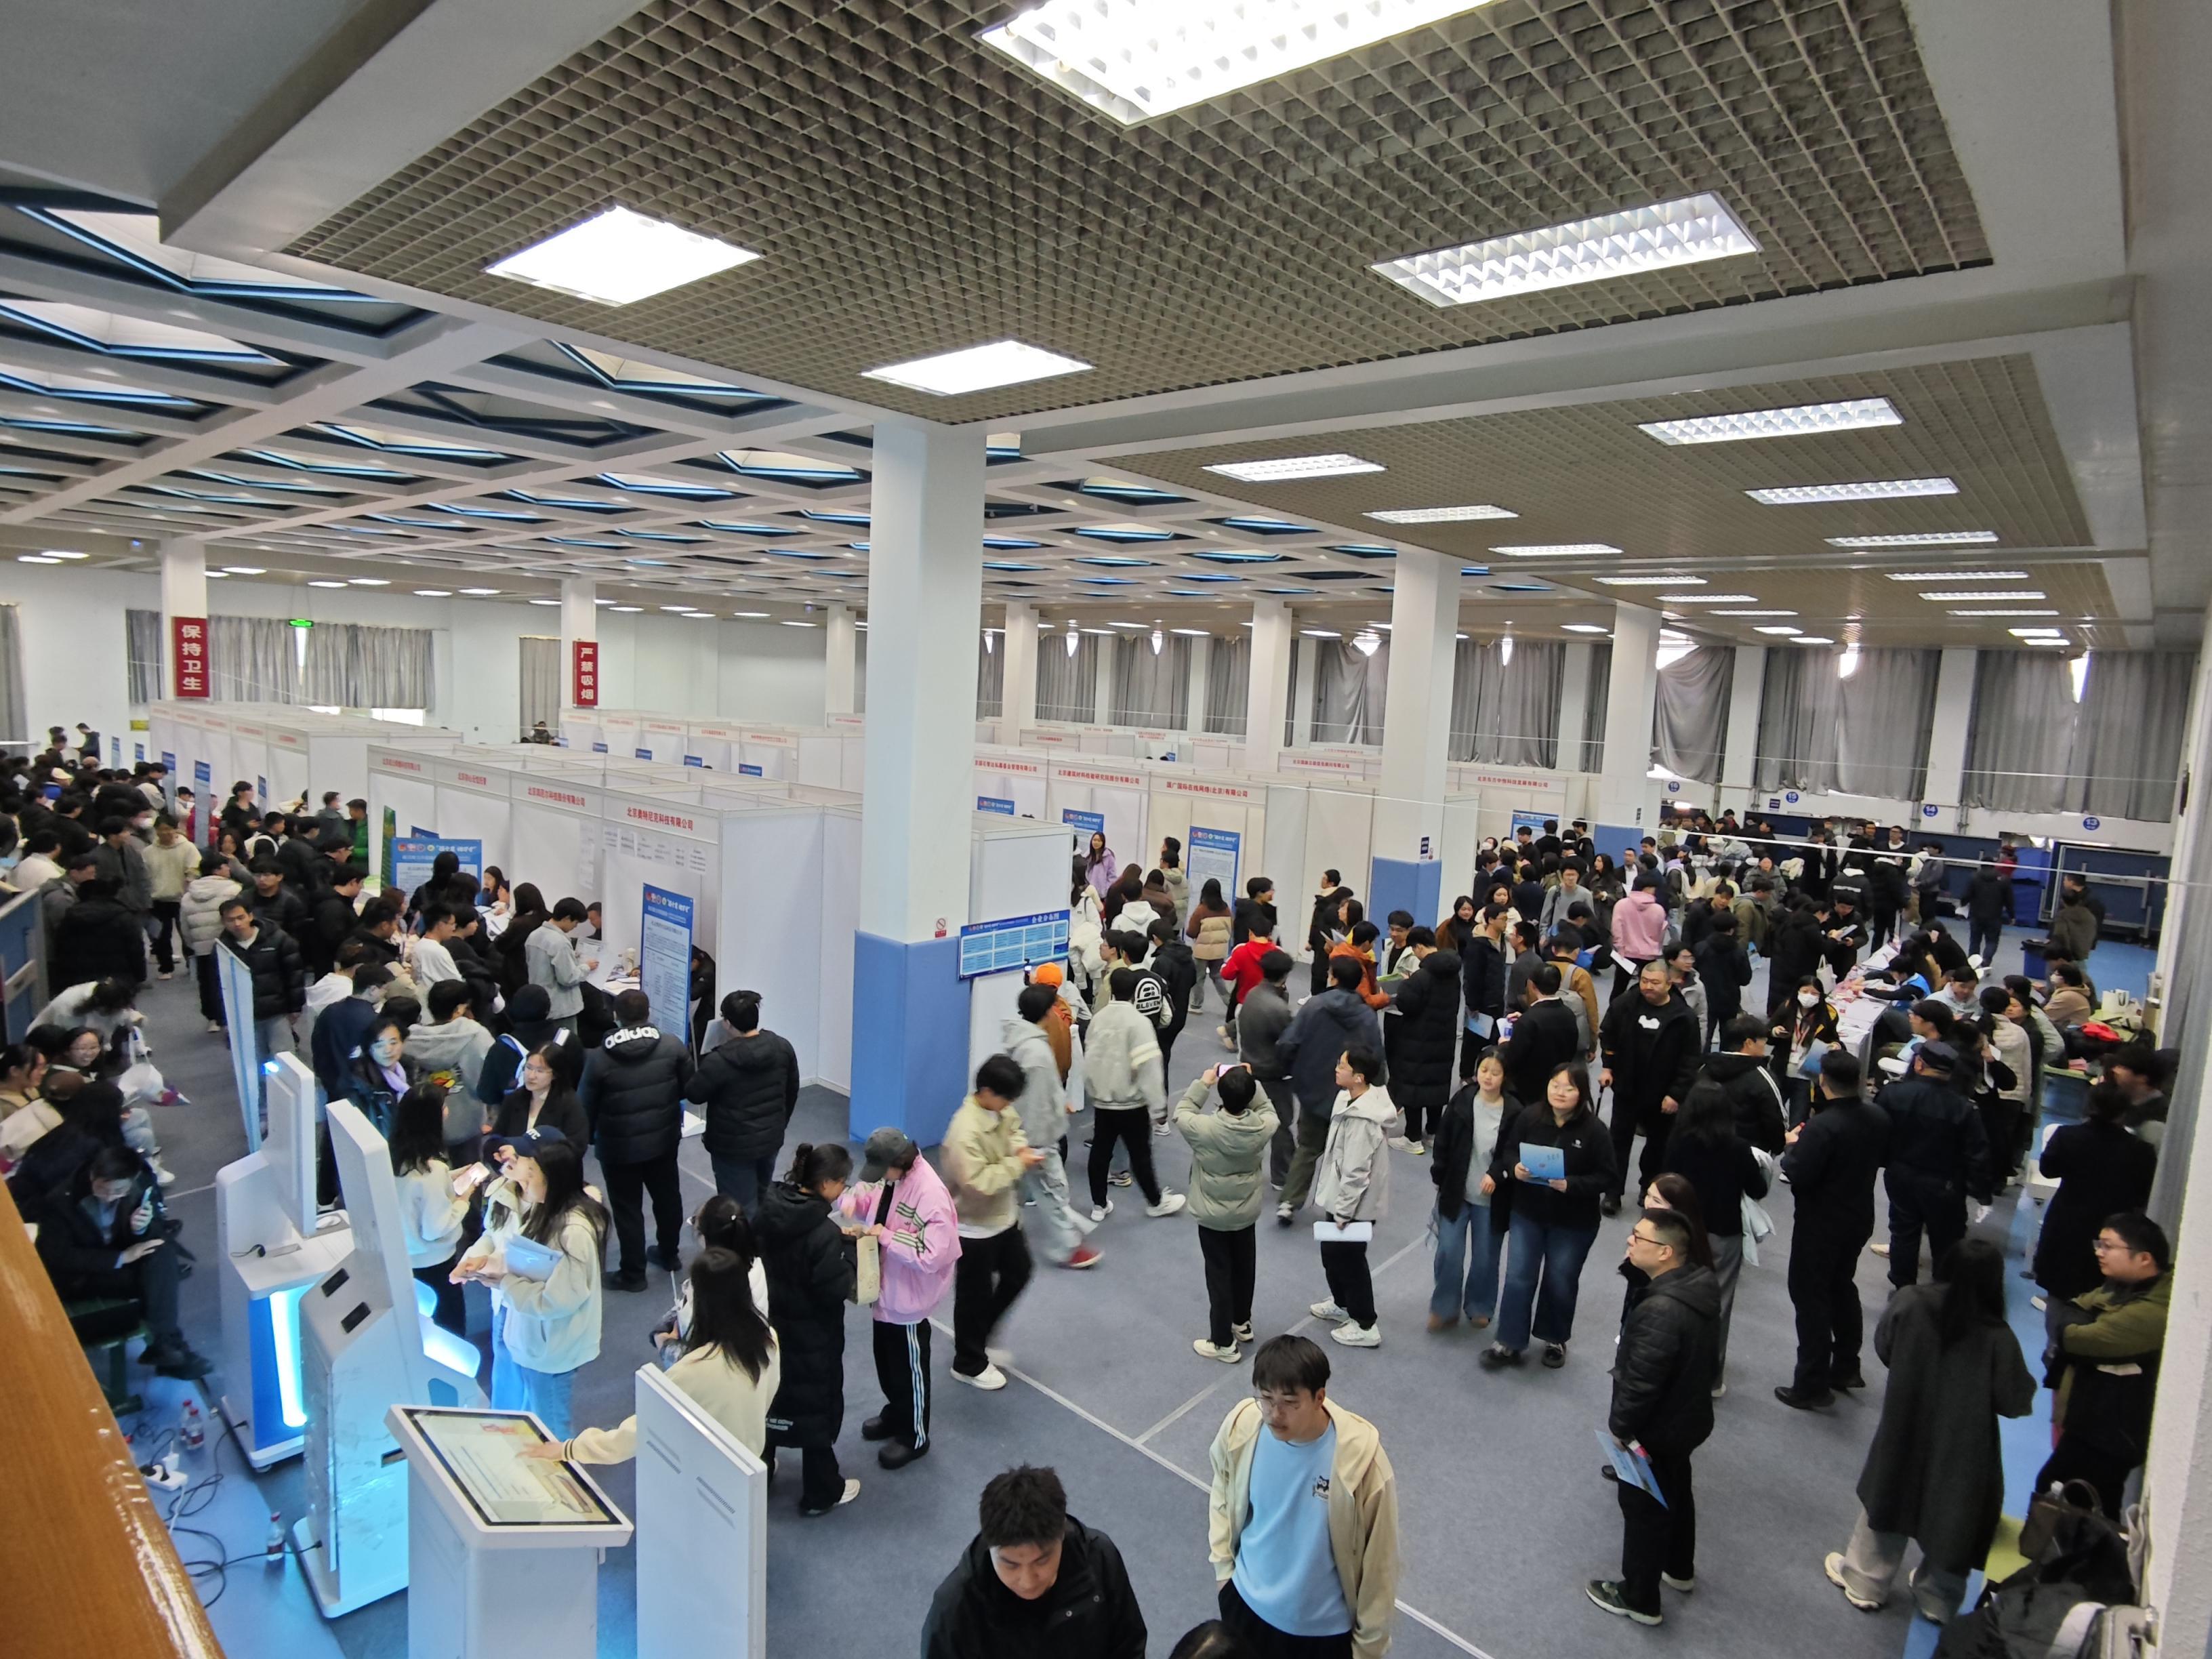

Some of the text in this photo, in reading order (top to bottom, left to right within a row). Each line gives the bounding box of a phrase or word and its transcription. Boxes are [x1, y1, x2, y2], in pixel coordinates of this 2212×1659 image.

[182, 625, 202, 690] 保持卫生
[580, 647, 594, 699] 严禁吸烟
[605, 1027, 659, 1049] adidas
